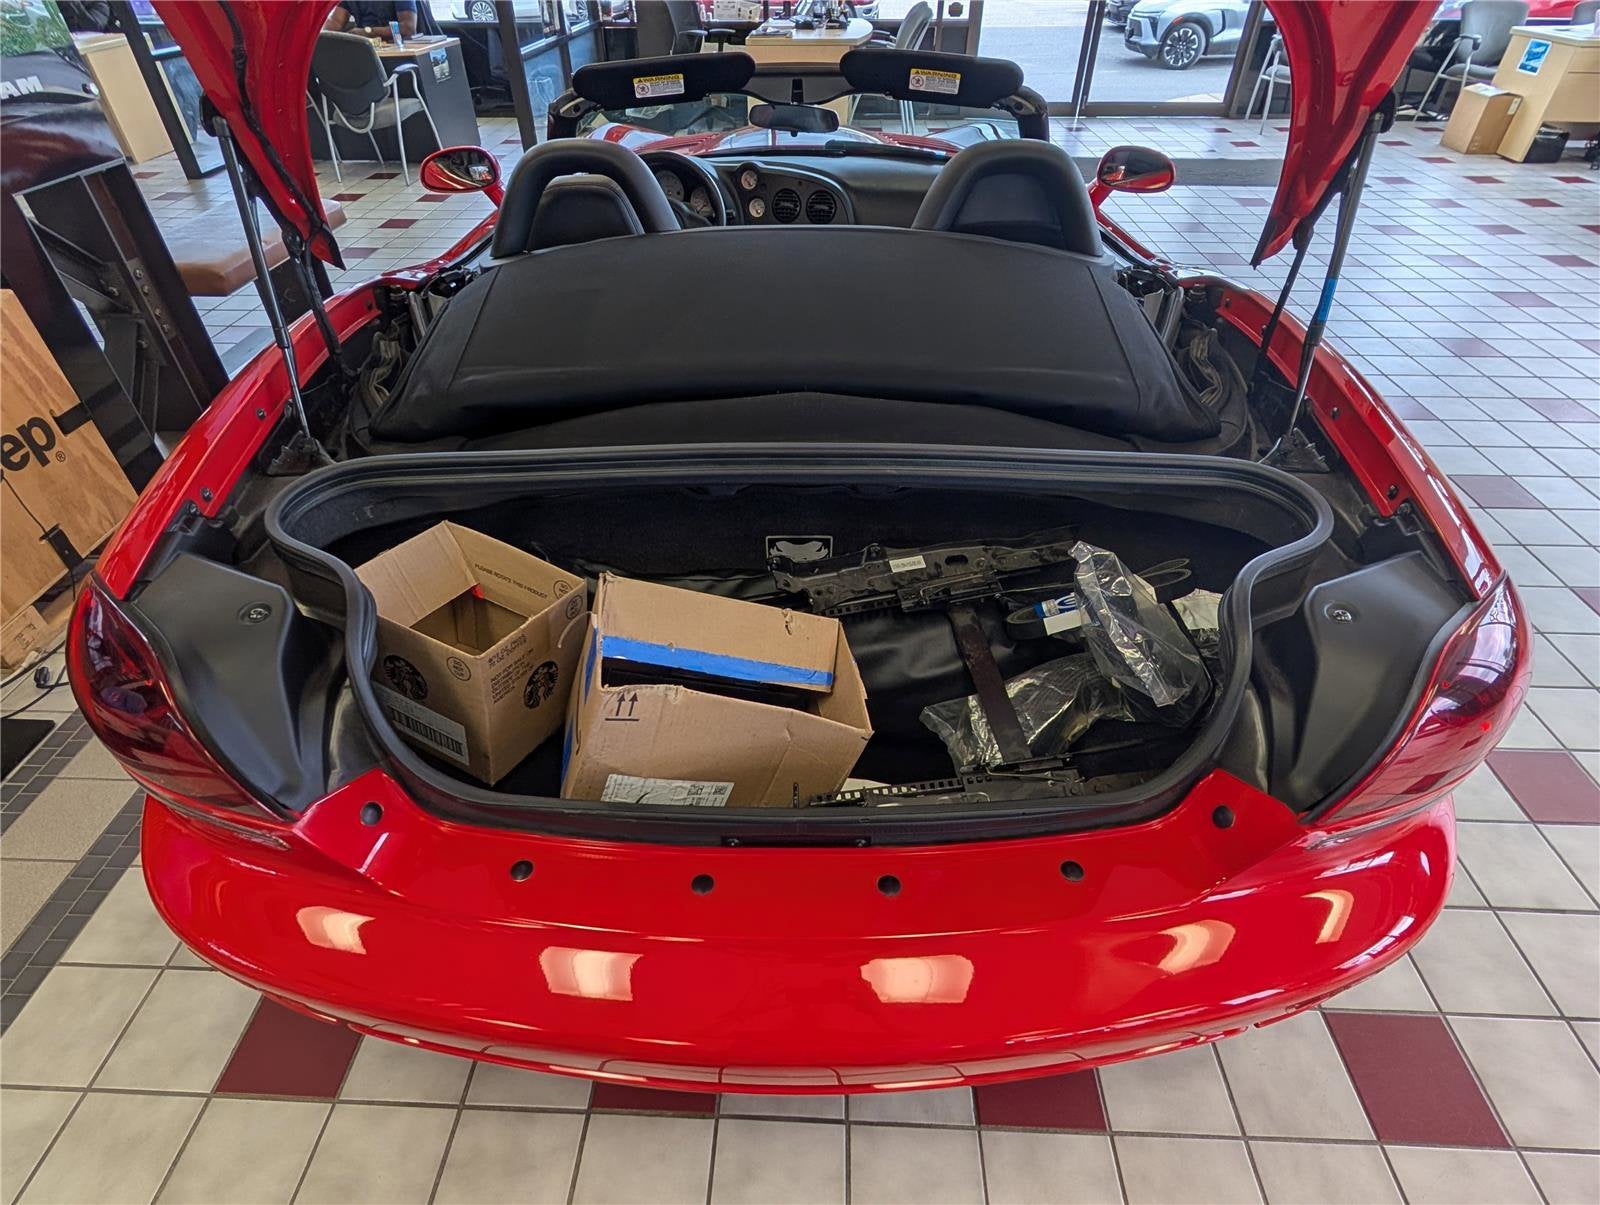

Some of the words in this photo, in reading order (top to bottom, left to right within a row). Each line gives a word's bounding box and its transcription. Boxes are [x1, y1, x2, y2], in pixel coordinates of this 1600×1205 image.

[642, 74, 680, 83] WARNING
[920, 70, 958, 79] WARNING
[0, 416, 56, 471] ep
